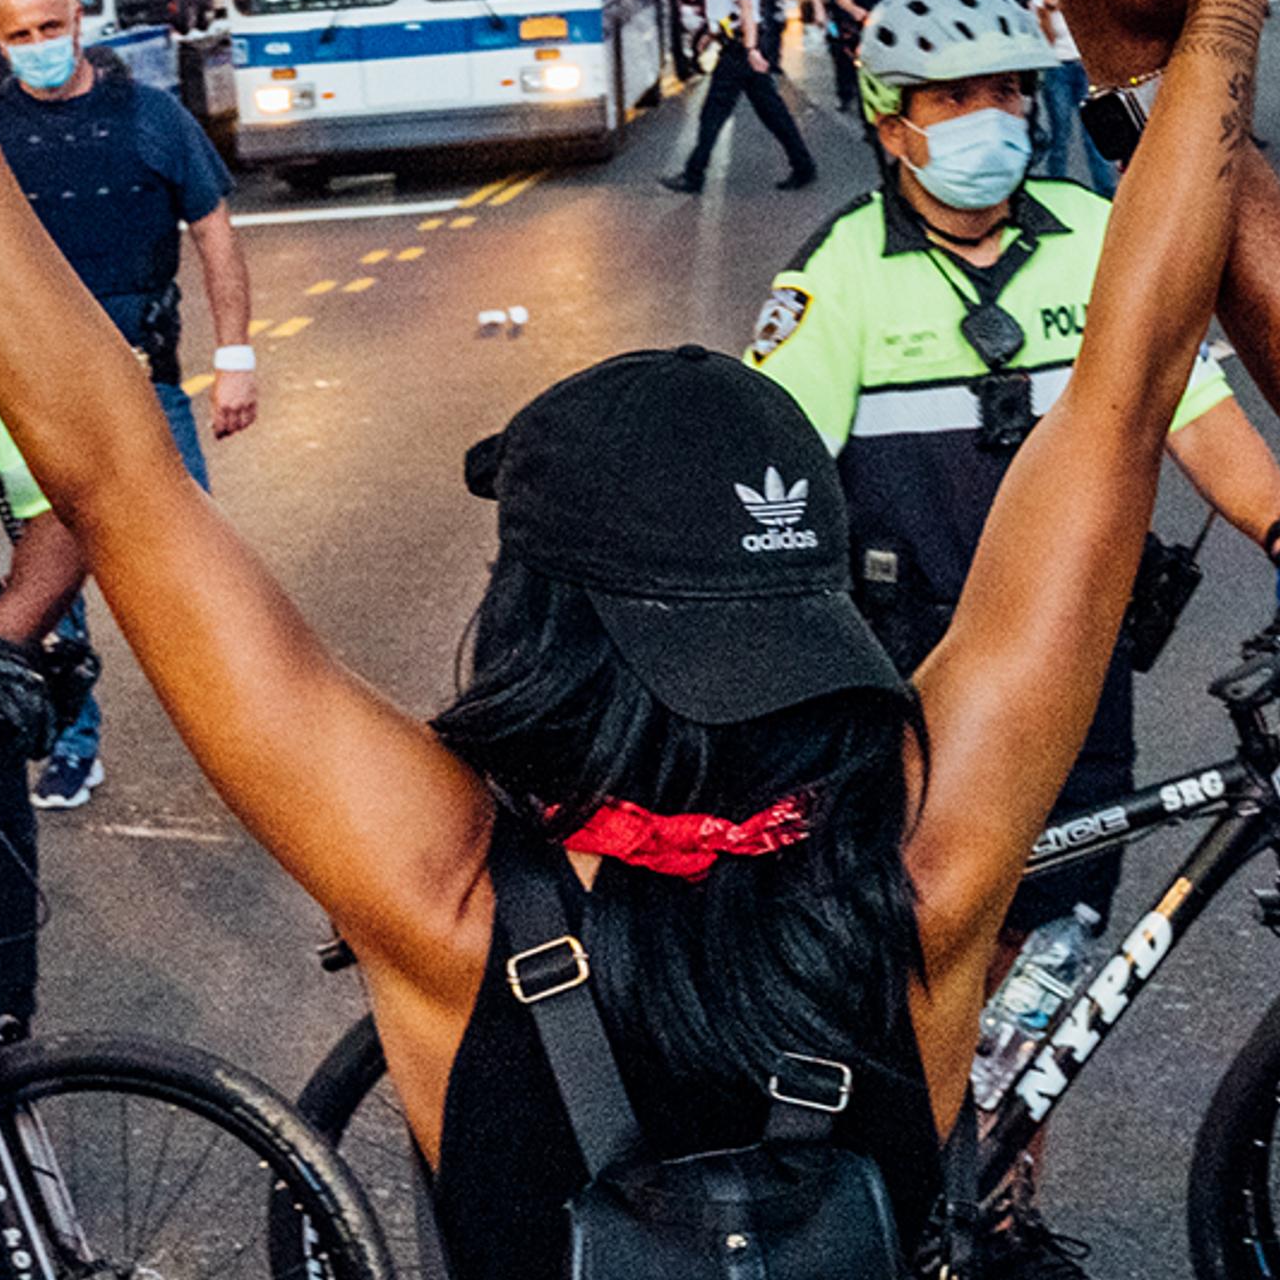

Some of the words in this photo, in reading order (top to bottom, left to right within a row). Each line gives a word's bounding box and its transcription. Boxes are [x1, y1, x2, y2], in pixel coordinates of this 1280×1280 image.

[1040, 304, 1088, 340] POL
[741, 526, 819, 553] adidas
[1031, 805, 1131, 859] LICE
[1159, 769, 1225, 812] SRG
[1014, 909, 1173, 1123] NYPD
